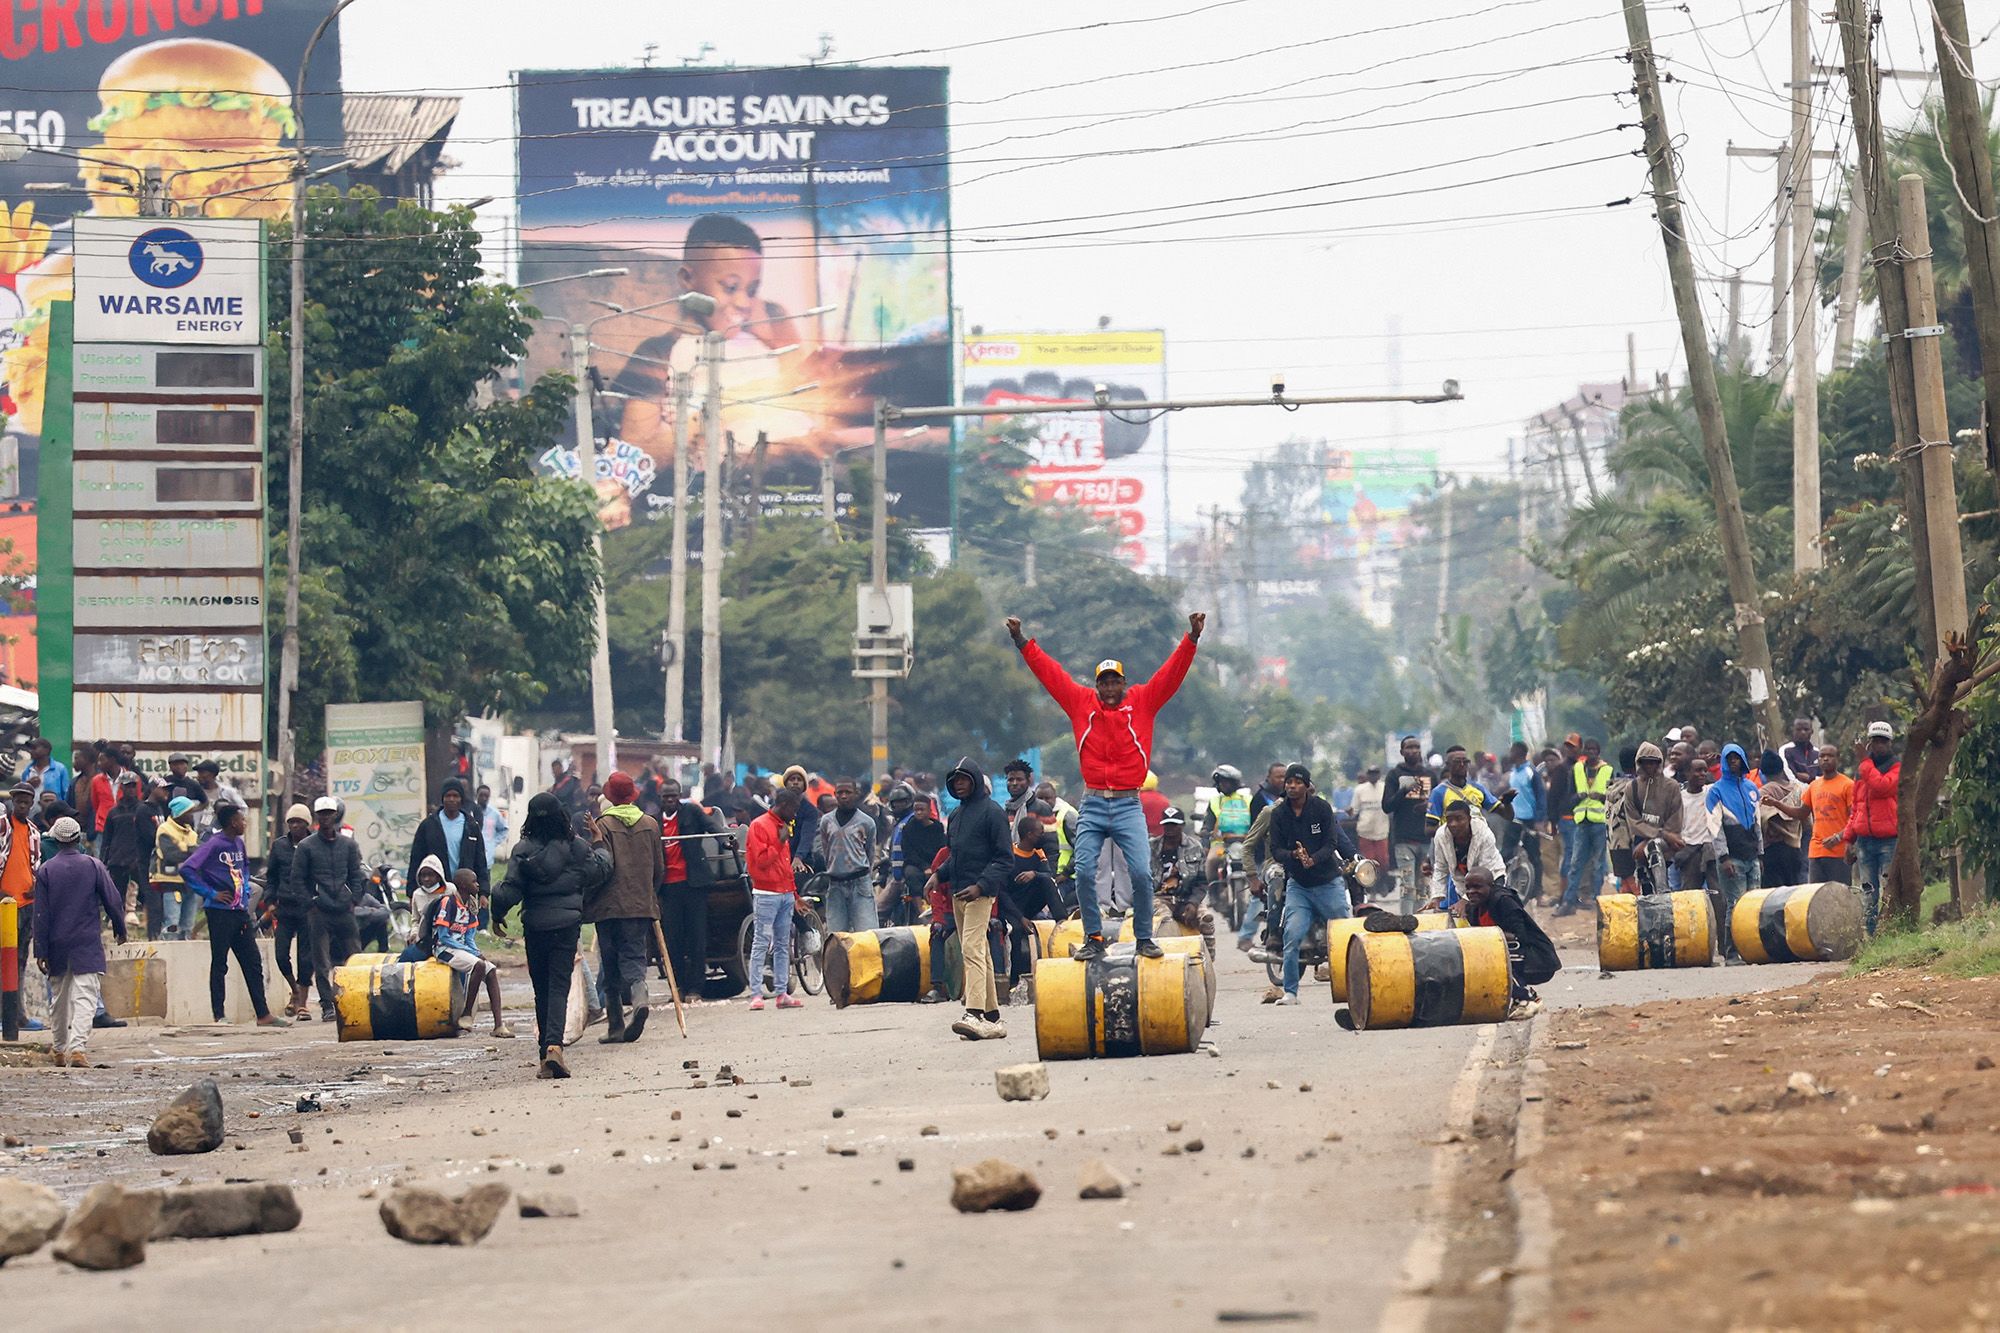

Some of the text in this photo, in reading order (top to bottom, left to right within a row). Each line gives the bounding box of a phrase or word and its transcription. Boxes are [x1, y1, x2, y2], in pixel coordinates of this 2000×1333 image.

[0, 0, 264, 60] CRU
[571, 94, 890, 127] TREASURE SAVINGS
[649, 130, 816, 162] ACCOUNT
[735, 166, 809, 185] financial
[98, 295, 243, 316] WARSAME
[176, 320, 243, 332] ENERGY
[100, 521, 145, 531] OPEN
[177, 520, 238, 532] HOURS
[77, 596, 155, 607] SERVICES
[187, 754, 258, 773] Feds
[333, 746, 421, 766] BOXER
[332, 780, 362, 794] TVS
